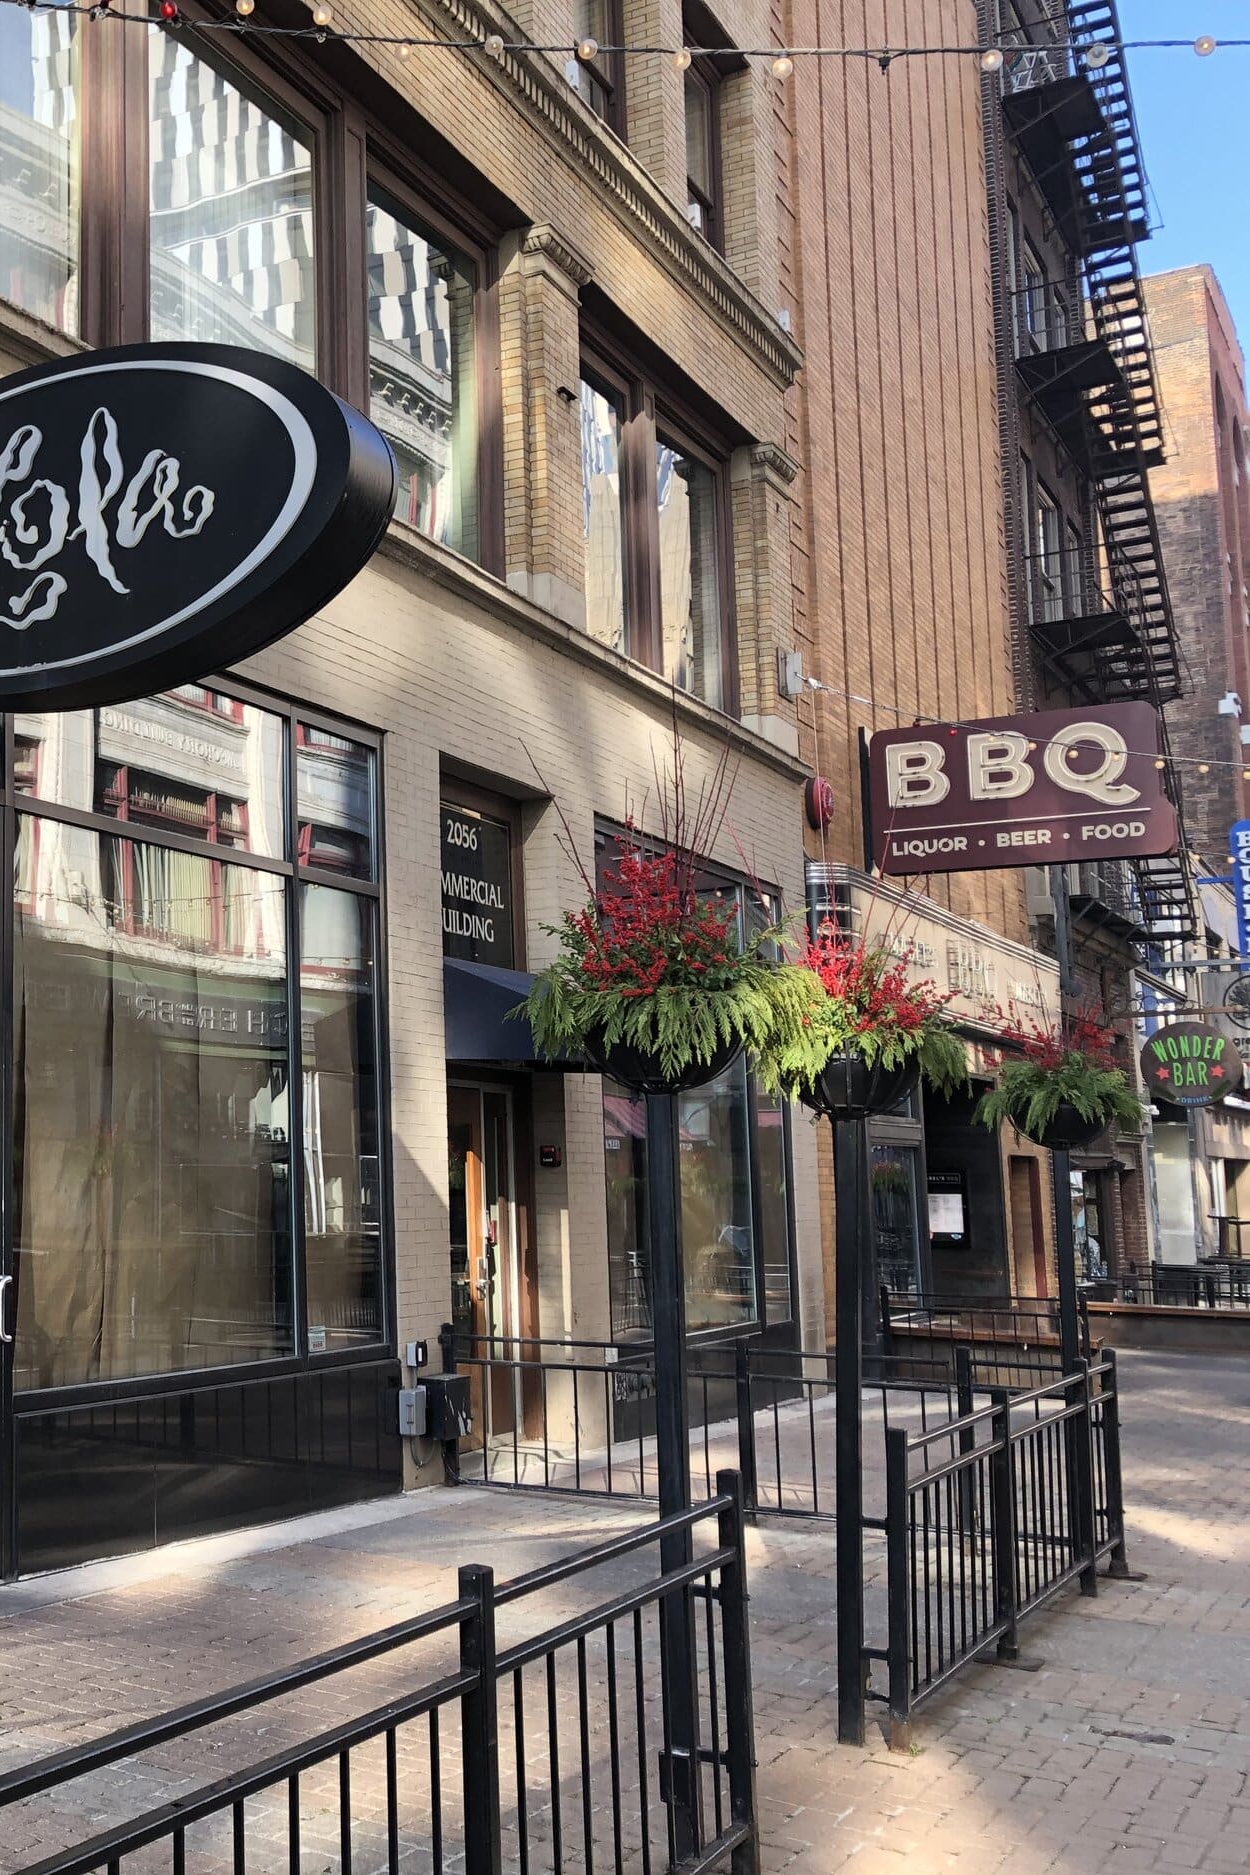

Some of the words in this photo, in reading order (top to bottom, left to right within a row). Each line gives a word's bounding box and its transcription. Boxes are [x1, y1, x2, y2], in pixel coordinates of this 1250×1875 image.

[885, 721, 1142, 808] BBQ
[446, 819, 478, 851] 2056
[892, 836, 968, 858] LIQUOR
[996, 829, 1052, 848] BEER
[1081, 822, 1146, 841] FOOD
[440, 869, 505, 909] MMERCIAL
[442, 908, 495, 943] UILDING
[1150, 1035, 1226, 1063] WONDER
[1172, 1061, 1209, 1087] BAR
